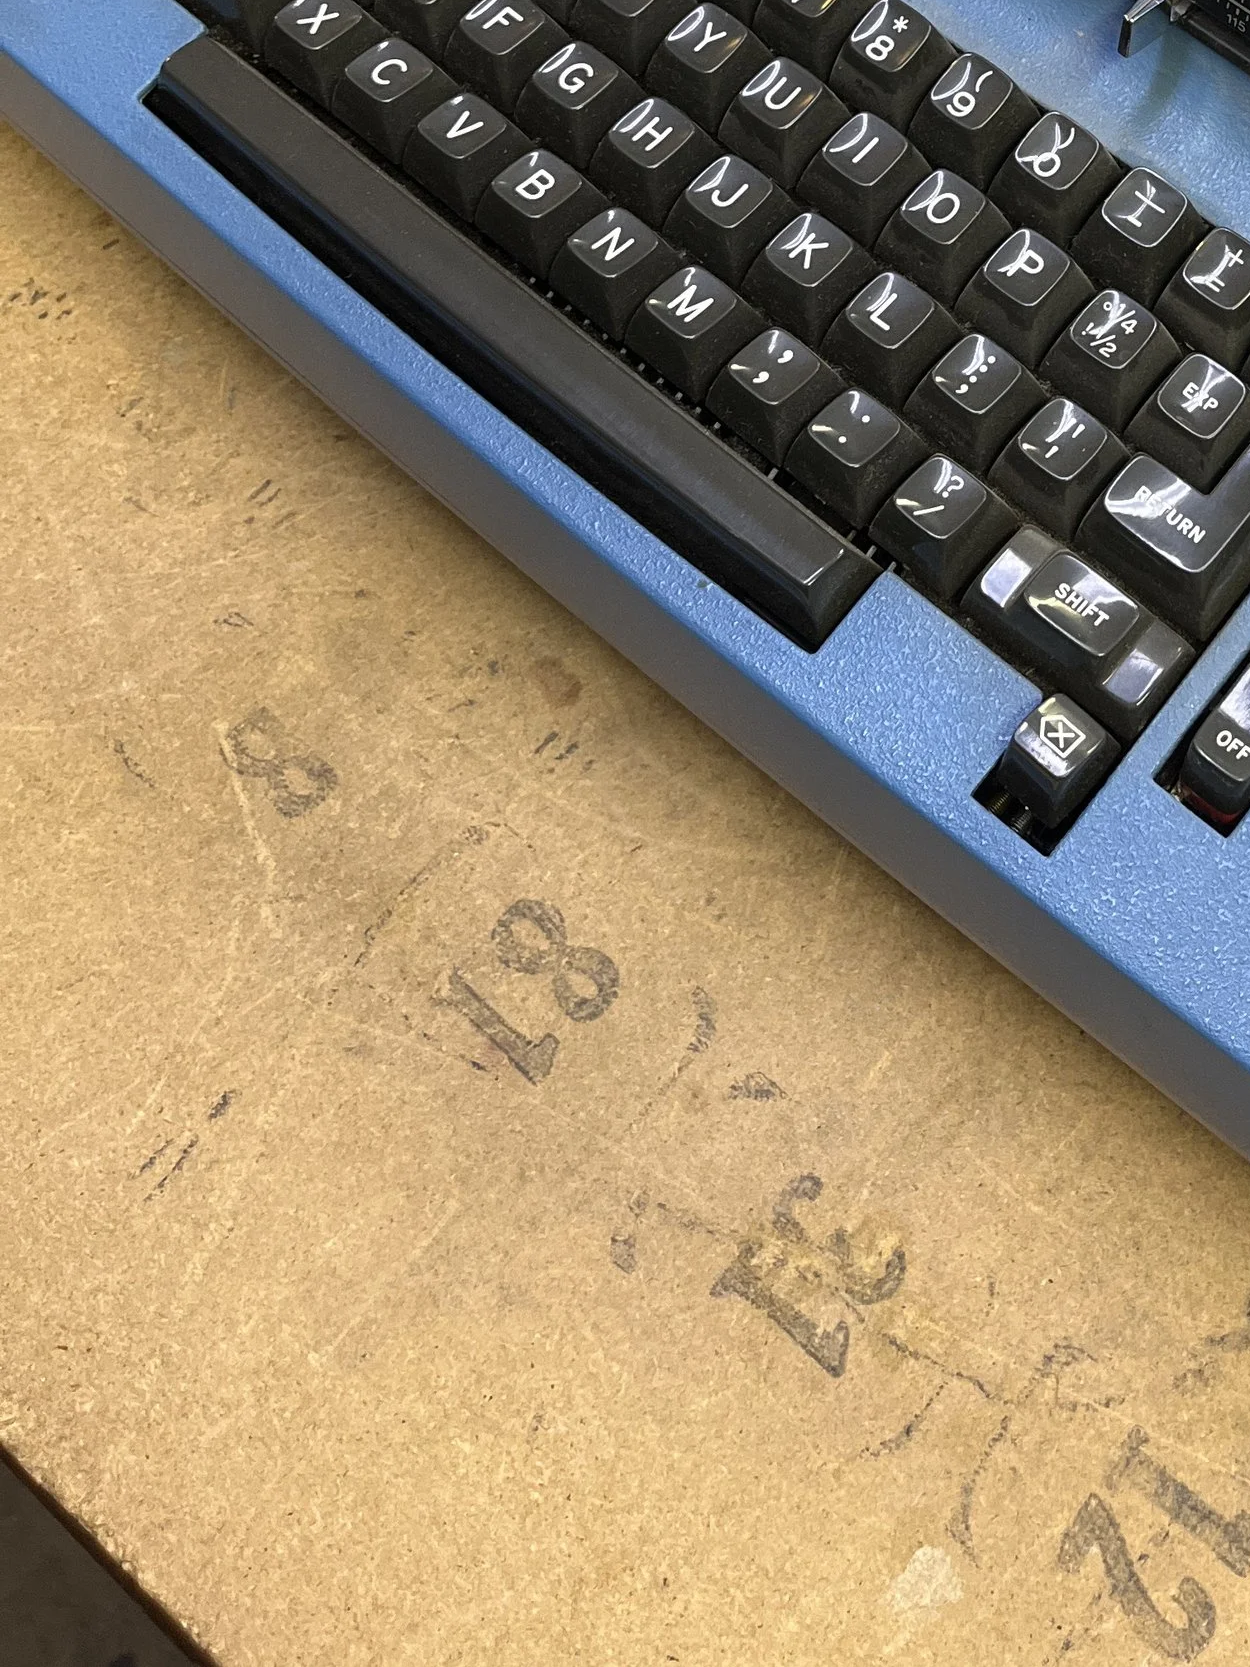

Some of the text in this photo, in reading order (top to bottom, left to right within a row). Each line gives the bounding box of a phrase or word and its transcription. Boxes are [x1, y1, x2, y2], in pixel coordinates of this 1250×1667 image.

[296, 2, 340, 35] X
[482, 5, 524, 30] F
[1226, 13, 1247, 33] 115
[693, 21, 727, 53] Y
[864, 34, 896, 62] 8
[371, 57, 409, 85] C
[558, 61, 594, 94] G
[764, 76, 801, 111] U
[945, 90, 976, 118] 9
[446, 109, 485, 139] V
[630, 115, 674, 152] H
[514, 167, 556, 201] B
[710, 183, 749, 208] J
[925, 191, 961, 225] O
[590, 226, 635, 262] N
[788, 231, 830, 270] K
[1005, 248, 1045, 278] P
[666, 283, 715, 324] M
[868, 292, 899, 331] L
[1182, 382, 1220, 412] EXP
[1054, 582, 1110, 628] SHIFT
